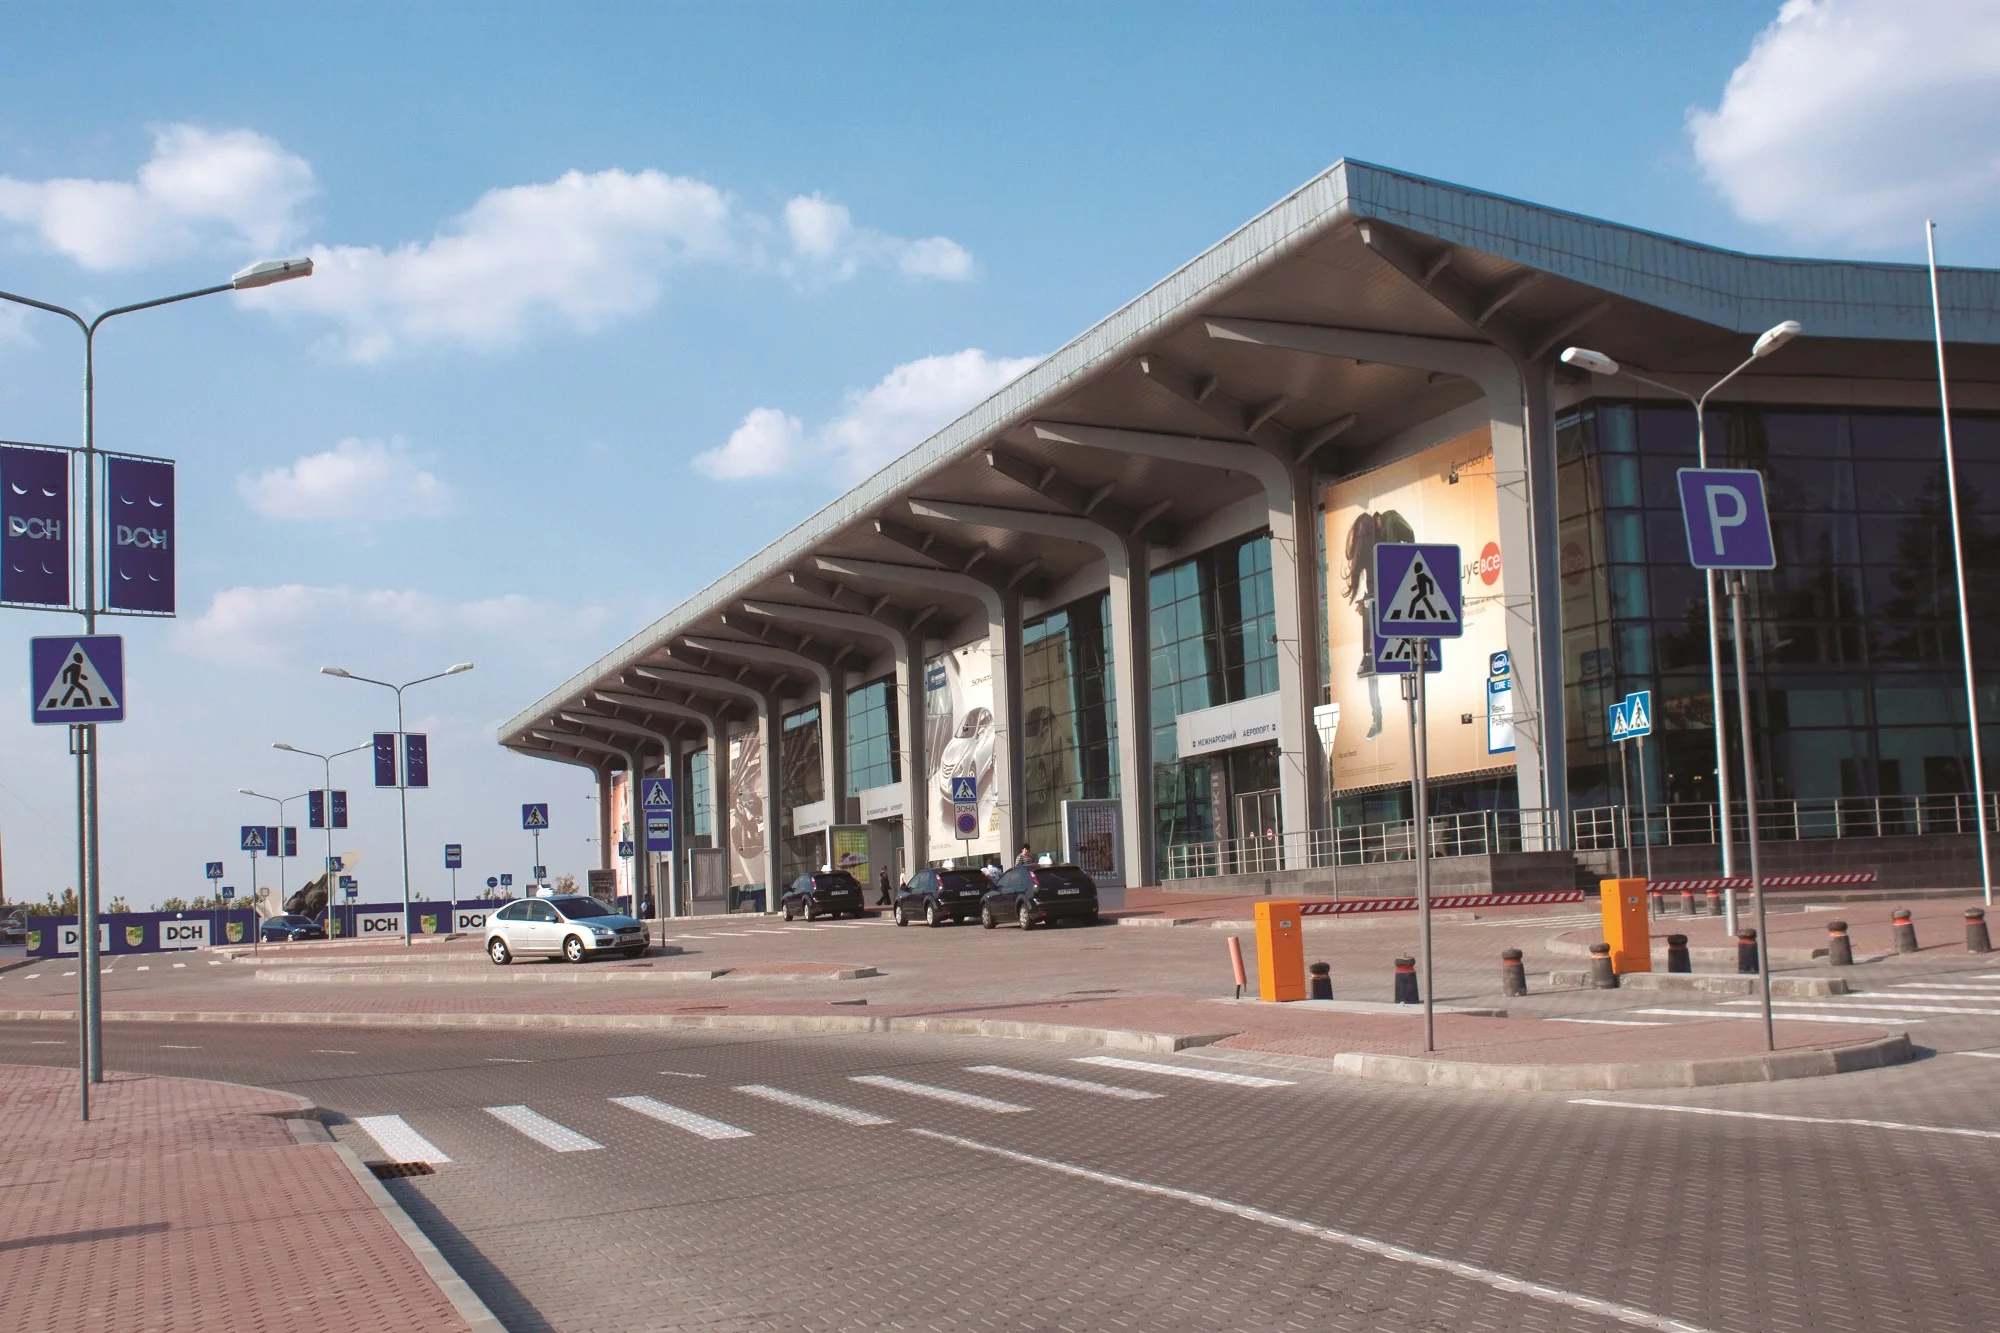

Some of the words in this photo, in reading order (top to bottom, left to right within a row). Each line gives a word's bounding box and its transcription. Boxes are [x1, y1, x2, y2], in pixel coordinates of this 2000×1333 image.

[9, 516, 60, 540] DCH
[1705, 485, 1747, 555] P
[117, 525, 167, 549] DCH
[1480, 553, 1500, 574] все
[1242, 724, 1270, 737] АЕРОПОРТ
[956, 805, 976, 813] ЗОНА
[167, 925, 203, 940] DCH
[363, 917, 398, 932] DCH
